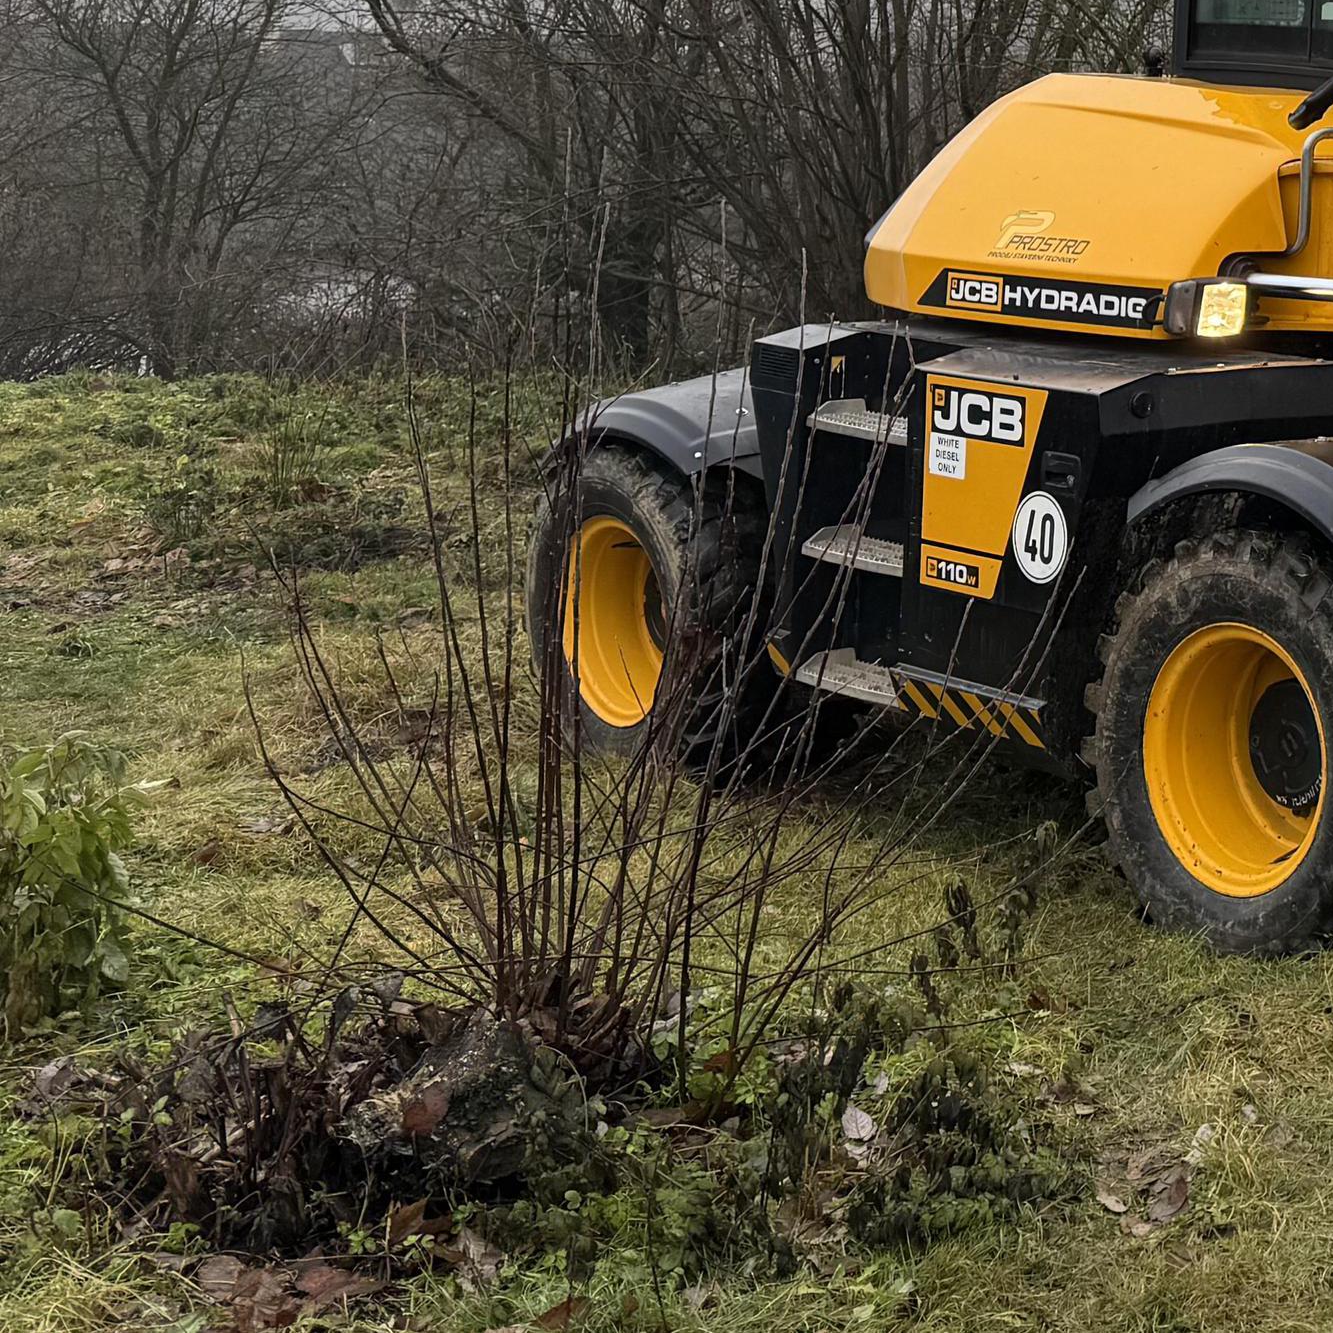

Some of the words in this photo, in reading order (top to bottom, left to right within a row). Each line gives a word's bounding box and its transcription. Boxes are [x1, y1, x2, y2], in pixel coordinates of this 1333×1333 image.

[1005, 235, 1090, 255] PROSTRO
[951, 280, 998, 304] JCB
[1004, 284, 1147, 318] HYDRADIG
[933, 390, 1023, 442] JCB
[937, 436, 960, 449] WHITE
[935, 449, 960, 462] DIESEL
[937, 462, 957, 475] ONLY
[1024, 509, 1055, 565] 40
